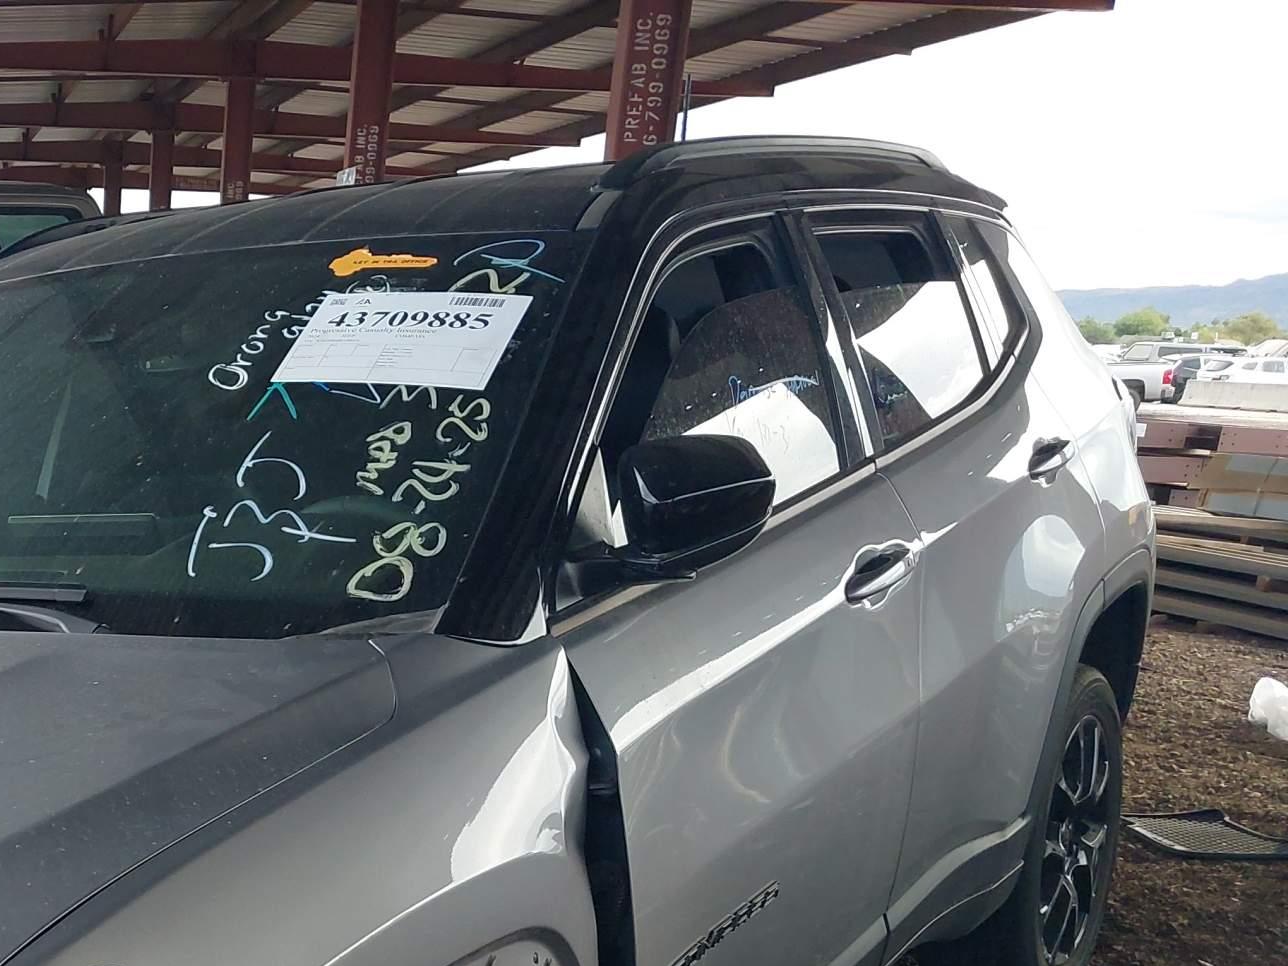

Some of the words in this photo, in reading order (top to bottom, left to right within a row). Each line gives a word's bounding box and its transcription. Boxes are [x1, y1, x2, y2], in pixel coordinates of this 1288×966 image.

[633, 11, 654, 51] INC.
[623, 62, 648, 142] PREFAB
[328, 310, 494, 330] 43709885
